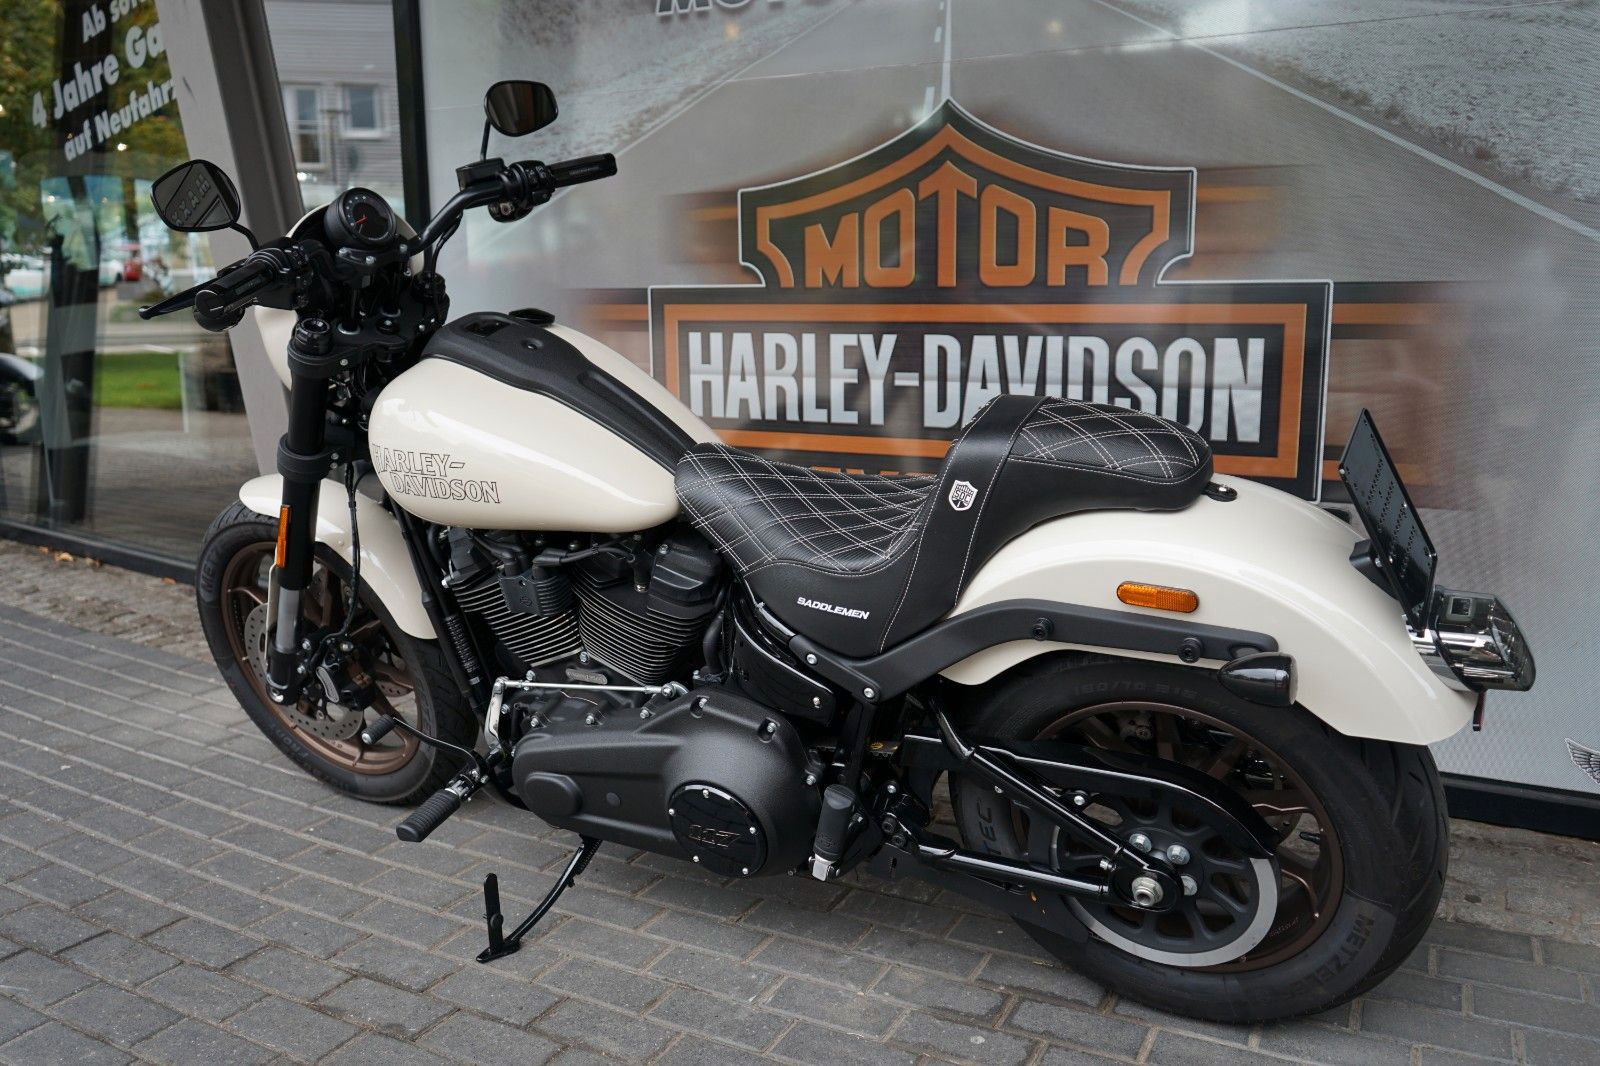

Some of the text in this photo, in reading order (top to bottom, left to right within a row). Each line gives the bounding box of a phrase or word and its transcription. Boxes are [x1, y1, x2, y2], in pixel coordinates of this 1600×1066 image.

[82, 2, 107, 44] Ab
[32, 91, 48, 129] 4
[52, 54, 120, 120] Jahre
[64, 121, 93, 162] auf
[804, 160, 1110, 289] MOTOR
[687, 331, 1265, 443] HARLEY-DAVIDSON
[389, 471, 502, 504] DAVIDSON
[797, 597, 870, 620] SADDLEMEN
